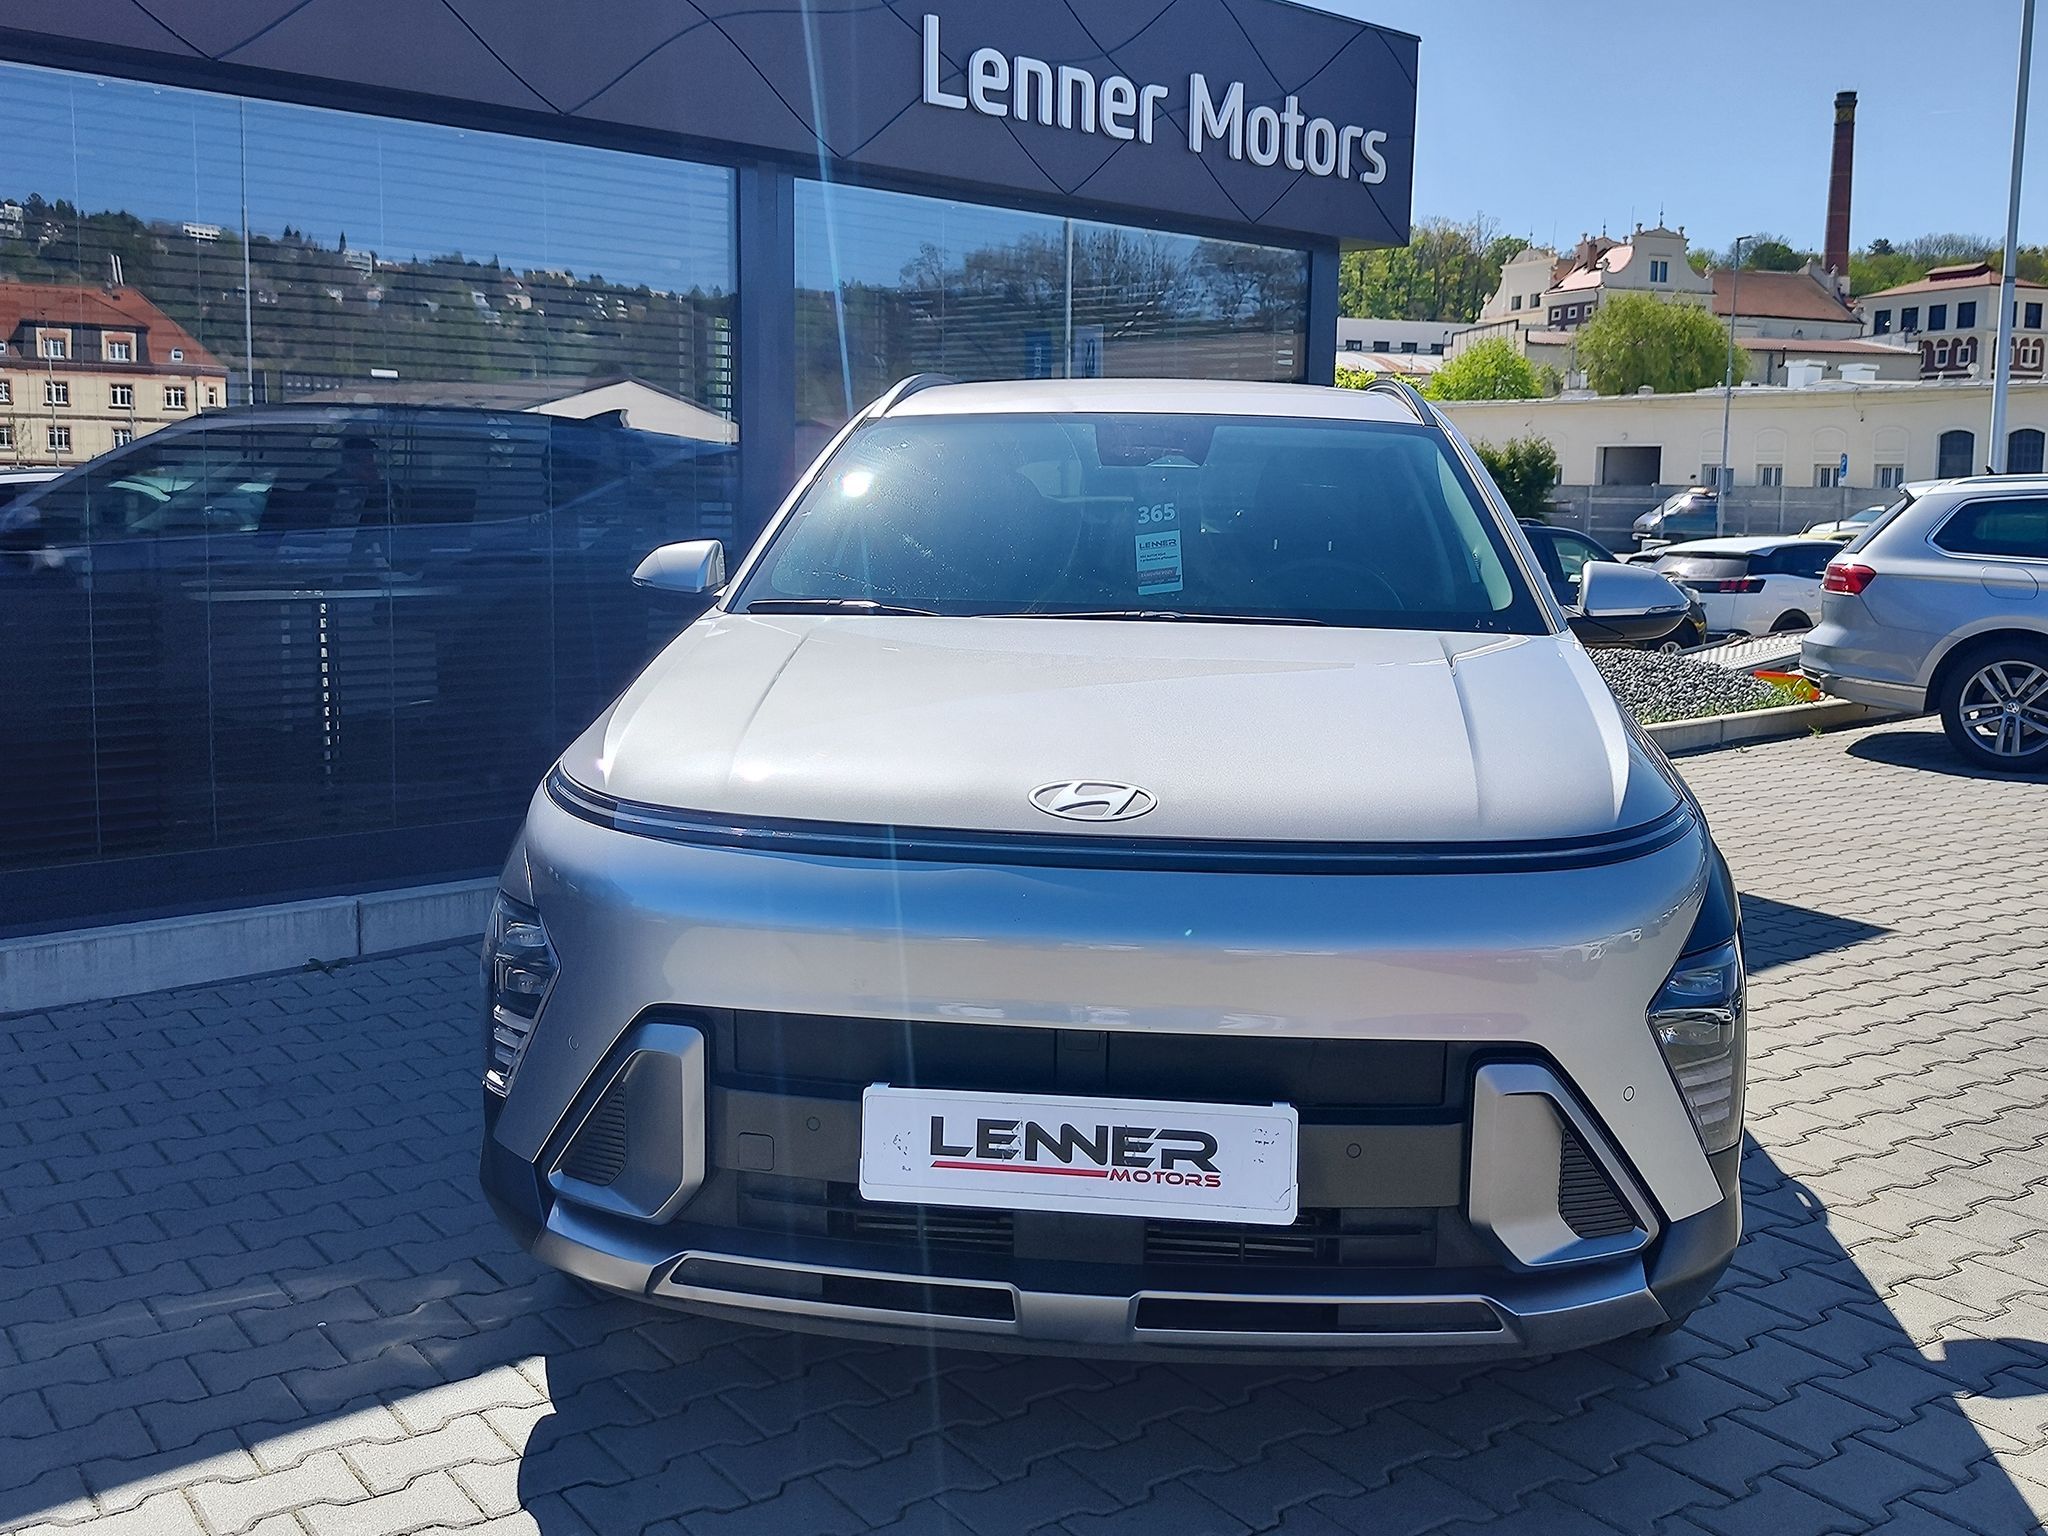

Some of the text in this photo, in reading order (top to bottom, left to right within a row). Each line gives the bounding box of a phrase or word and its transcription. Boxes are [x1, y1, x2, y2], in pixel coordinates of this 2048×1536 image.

[923, 14, 1388, 184] Lenner Motors
[1138, 502, 1176, 524] 365
[930, 1116, 1222, 1173] LENNER
[1109, 1168, 1222, 1188] MOTORS
